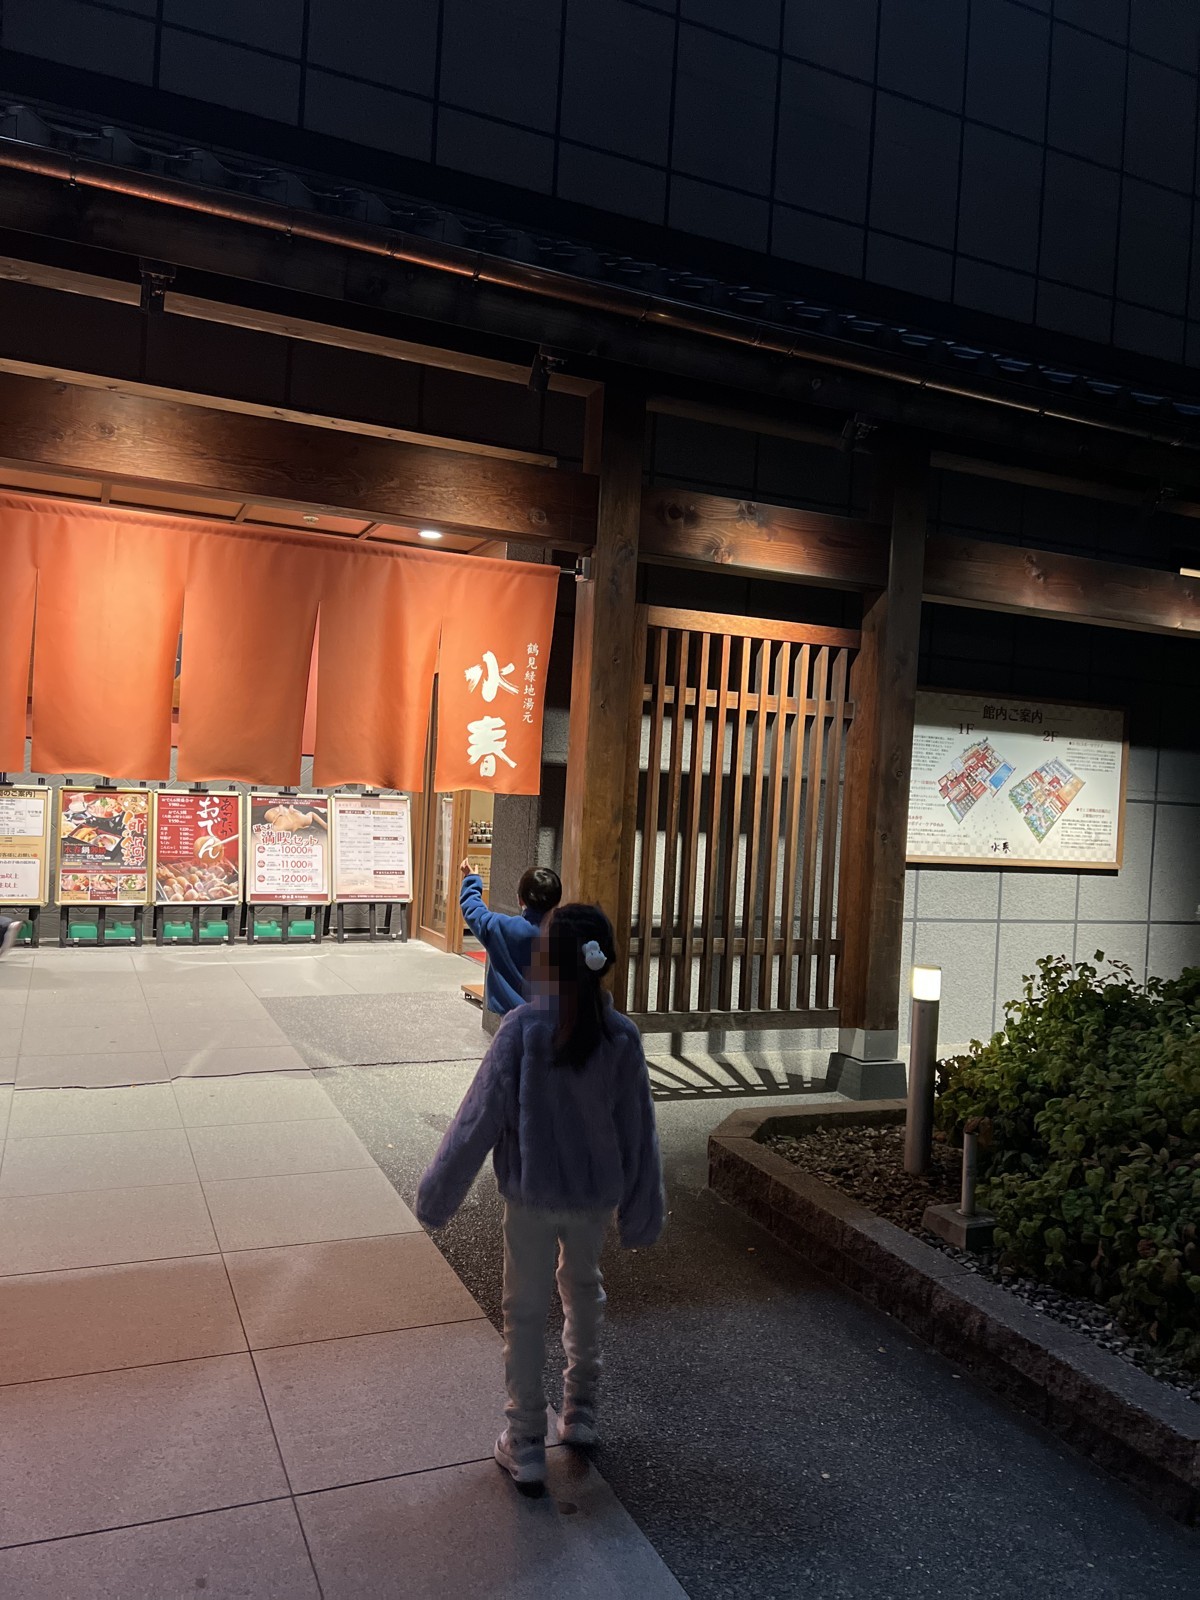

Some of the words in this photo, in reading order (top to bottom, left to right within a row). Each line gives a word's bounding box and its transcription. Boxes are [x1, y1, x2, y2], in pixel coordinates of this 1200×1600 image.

[522, 642, 539, 724] 鶴見緑地湯元
[464, 650, 520, 777] 水春
[982, 704, 1043, 724] 館内ご案内
[958, 723, 975, 735] 1F
[1042, 730, 1060, 742] 2F
[196, 797, 221, 859] おでん
[262, 831, 319, 845] 満喫セット
